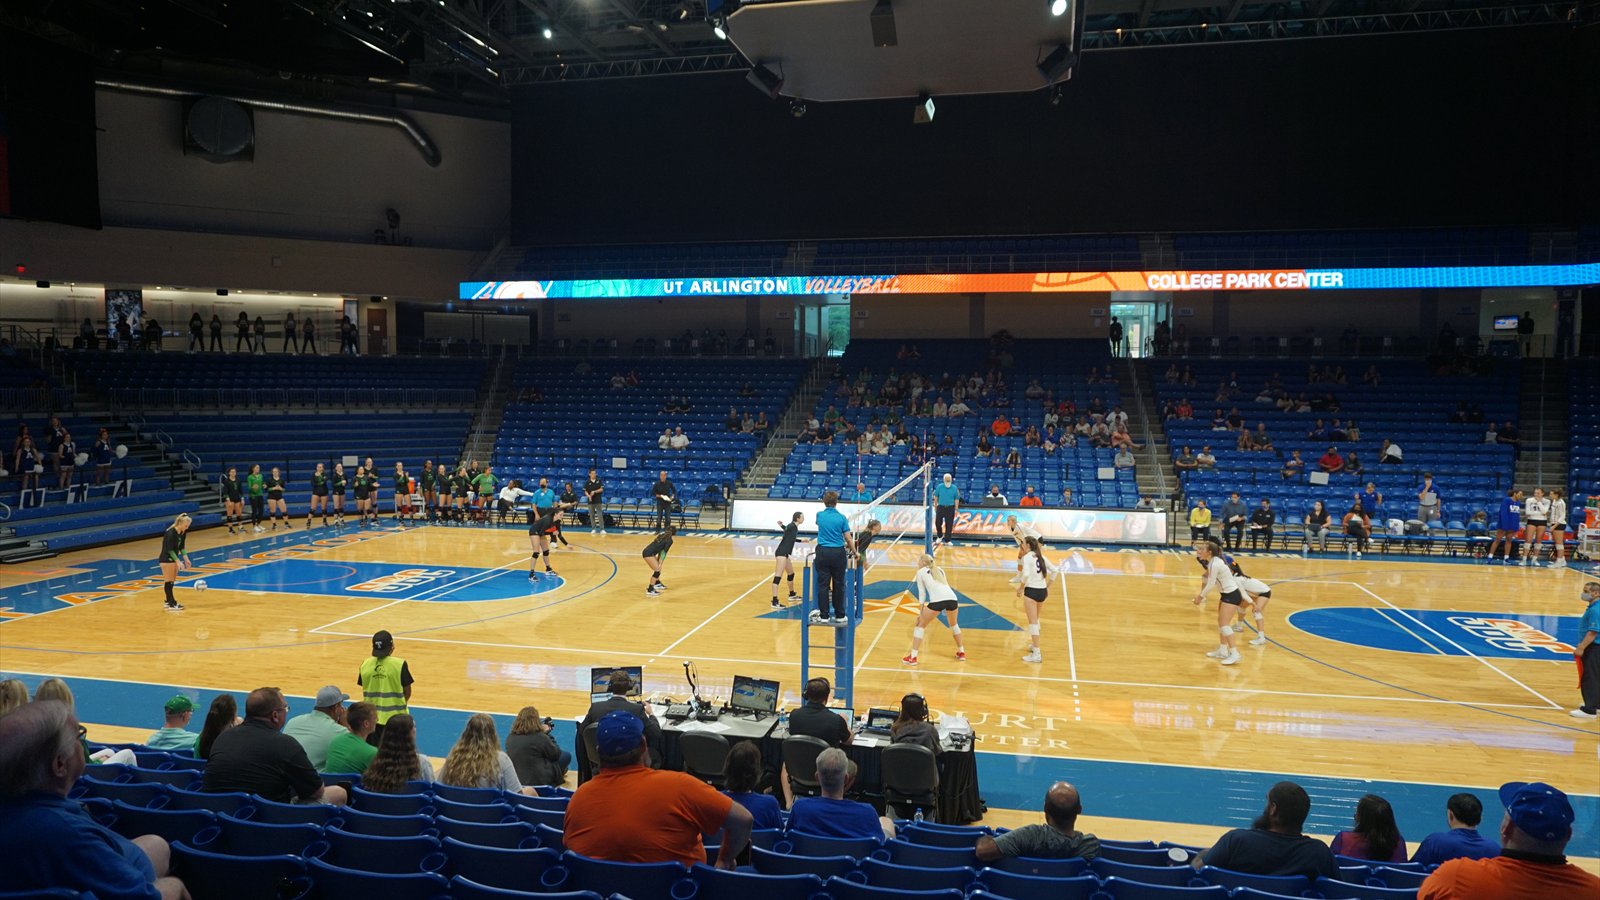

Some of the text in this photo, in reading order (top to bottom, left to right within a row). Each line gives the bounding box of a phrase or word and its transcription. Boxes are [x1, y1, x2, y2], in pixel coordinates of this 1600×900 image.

[663, 279, 788, 294] UT ARLINGTON
[805, 277, 901, 293] VOLLEYBALL
[1147, 271, 1344, 289] COLLEGE PARK CENTER
[887, 511, 1005, 531] VOLBALL
[960, 542, 1057, 552] TEXS
[1118, 548, 1304, 560] ARLITON
[1035, 559, 1044, 574] 9
[374, 640, 383, 649] T
[974, 733, 1072, 750] TER
